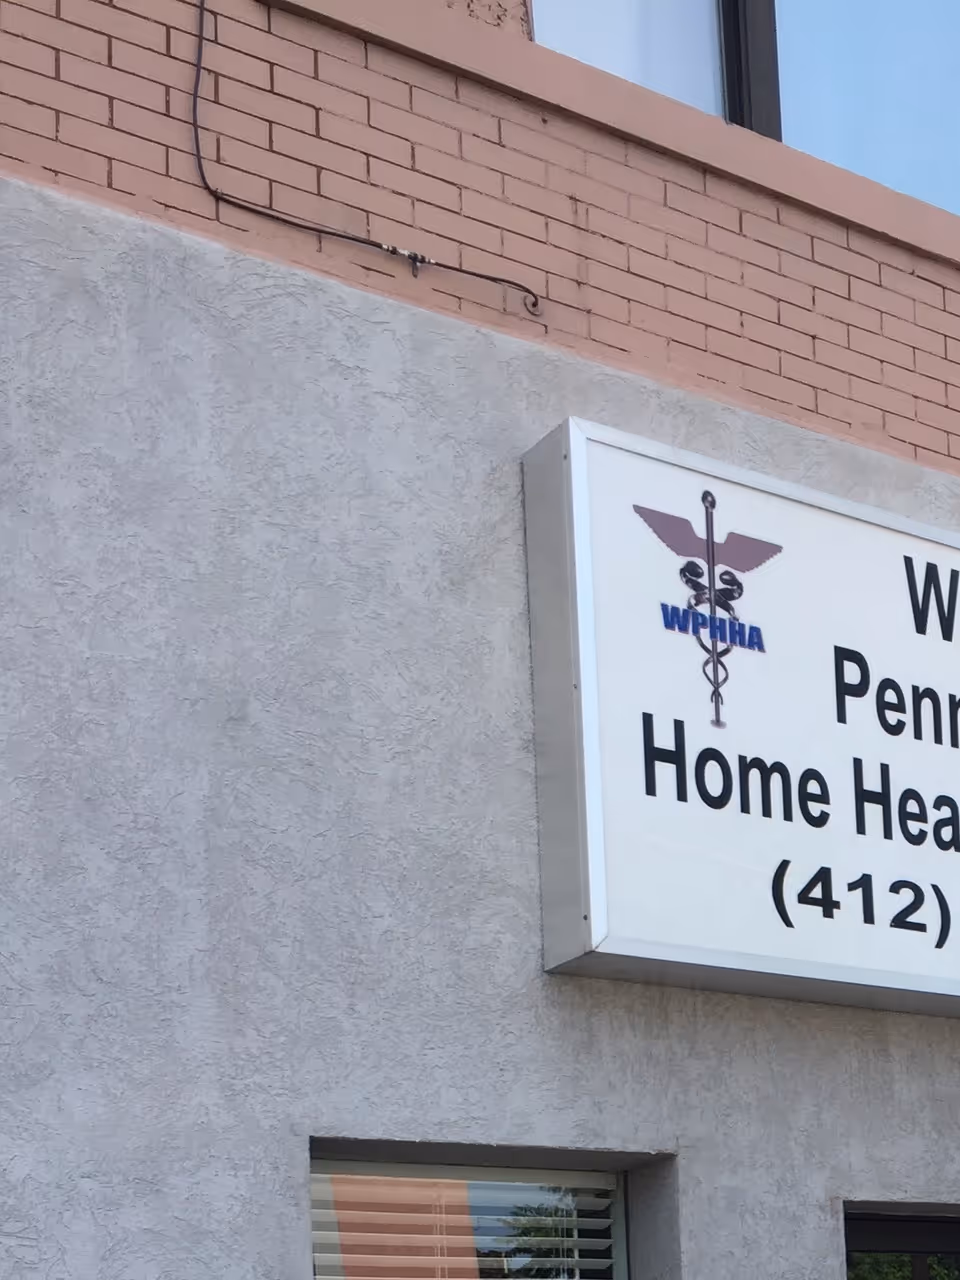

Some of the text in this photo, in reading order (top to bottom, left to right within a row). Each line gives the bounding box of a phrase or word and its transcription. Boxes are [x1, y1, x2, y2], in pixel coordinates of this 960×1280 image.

[660, 602, 766, 653] WPHHA
[641, 711, 831, 828] Home
[771, 858, 952, 950] (412)
